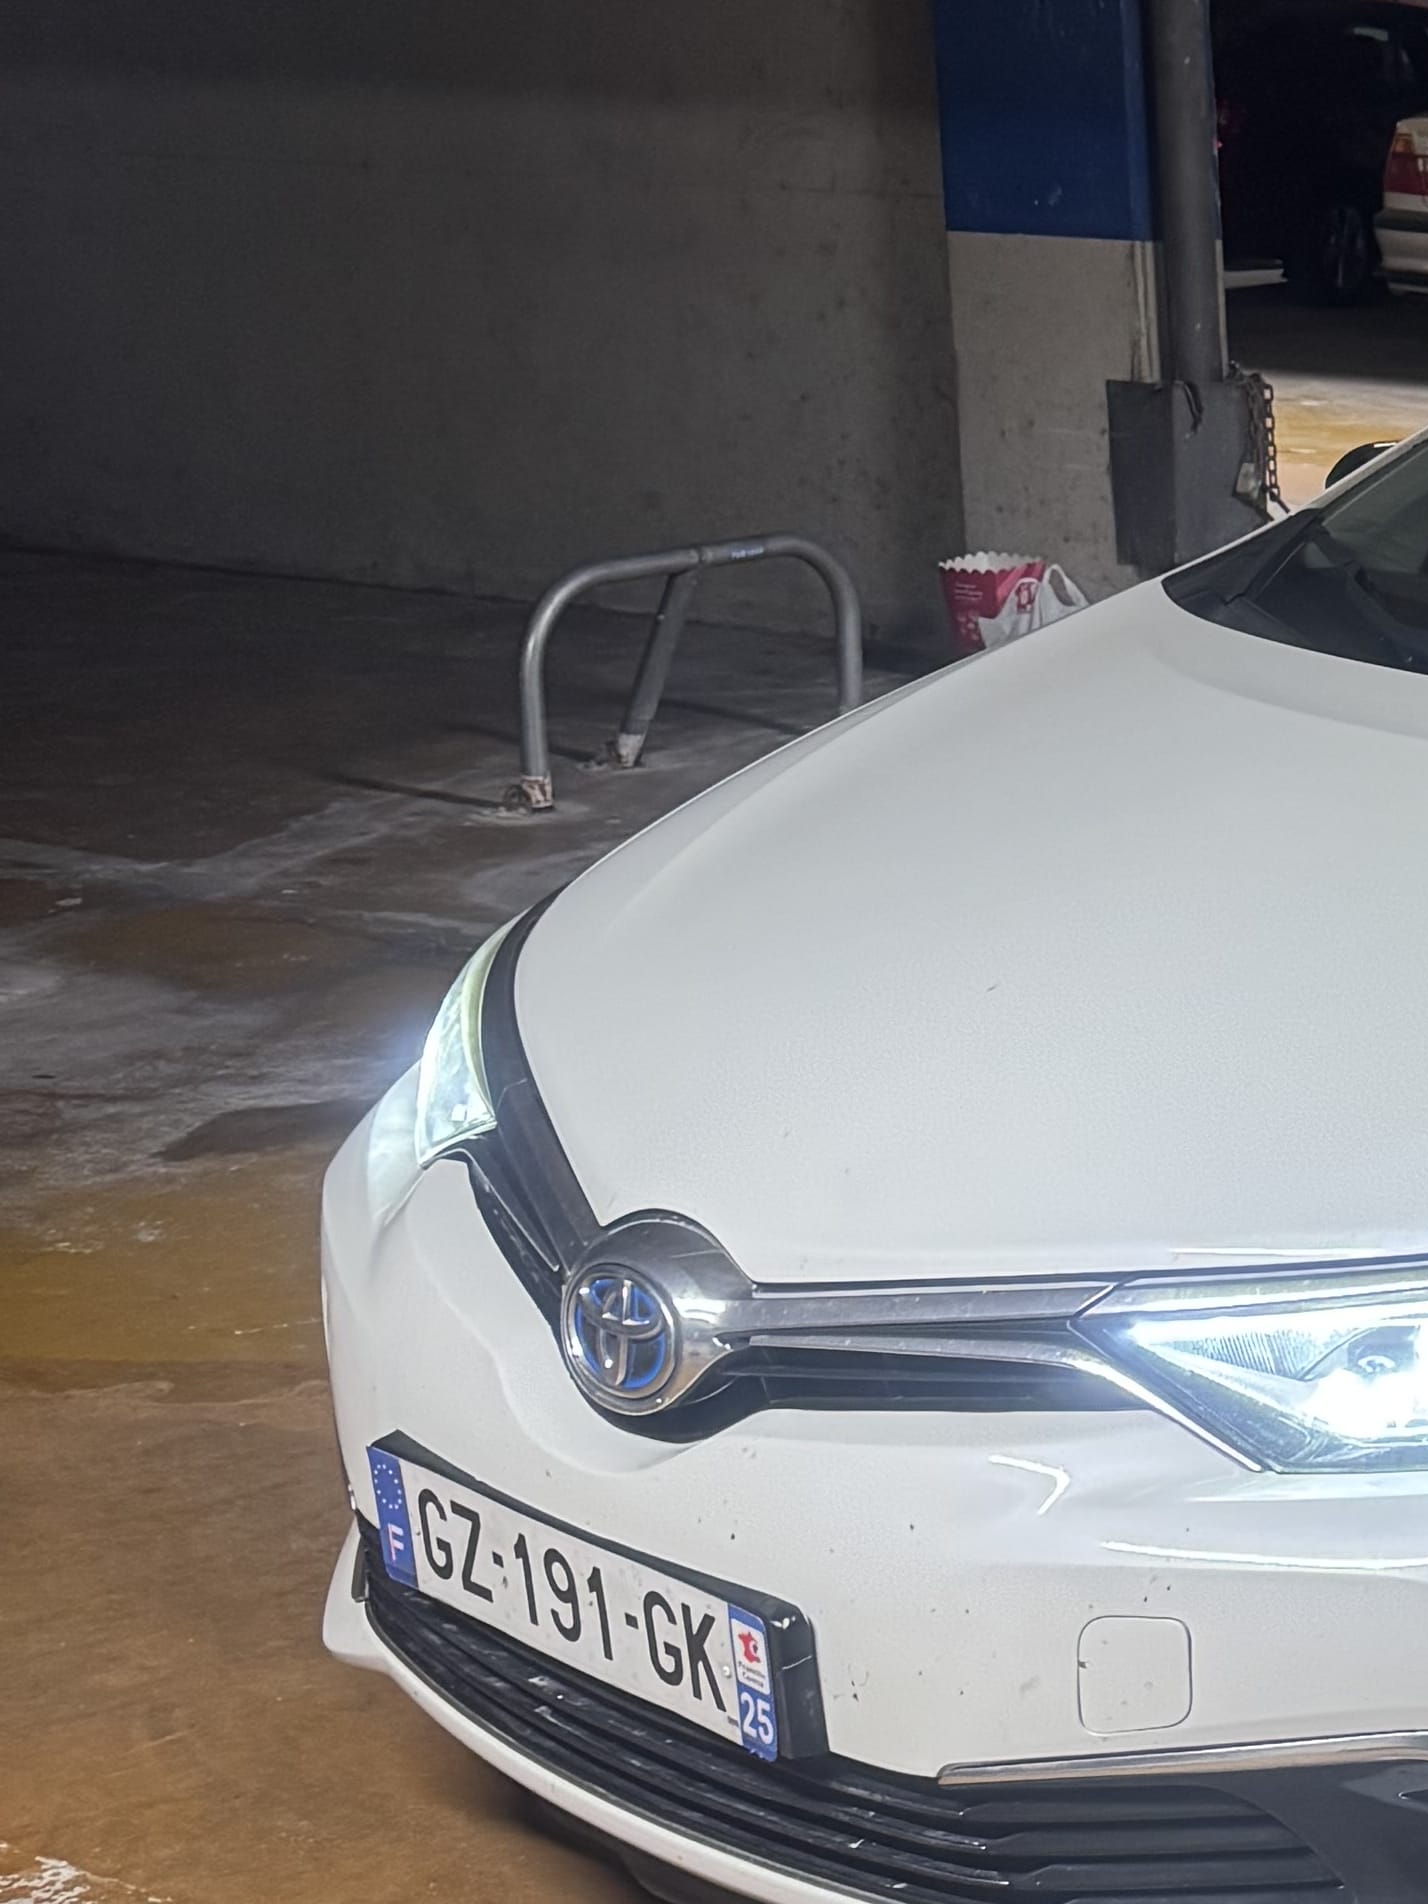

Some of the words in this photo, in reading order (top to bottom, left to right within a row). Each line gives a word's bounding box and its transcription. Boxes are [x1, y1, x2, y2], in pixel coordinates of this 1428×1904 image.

[387, 1522, 405, 1561] F
[417, 1487, 727, 1712] GZ-191-GK
[740, 1690, 774, 1745] 25
